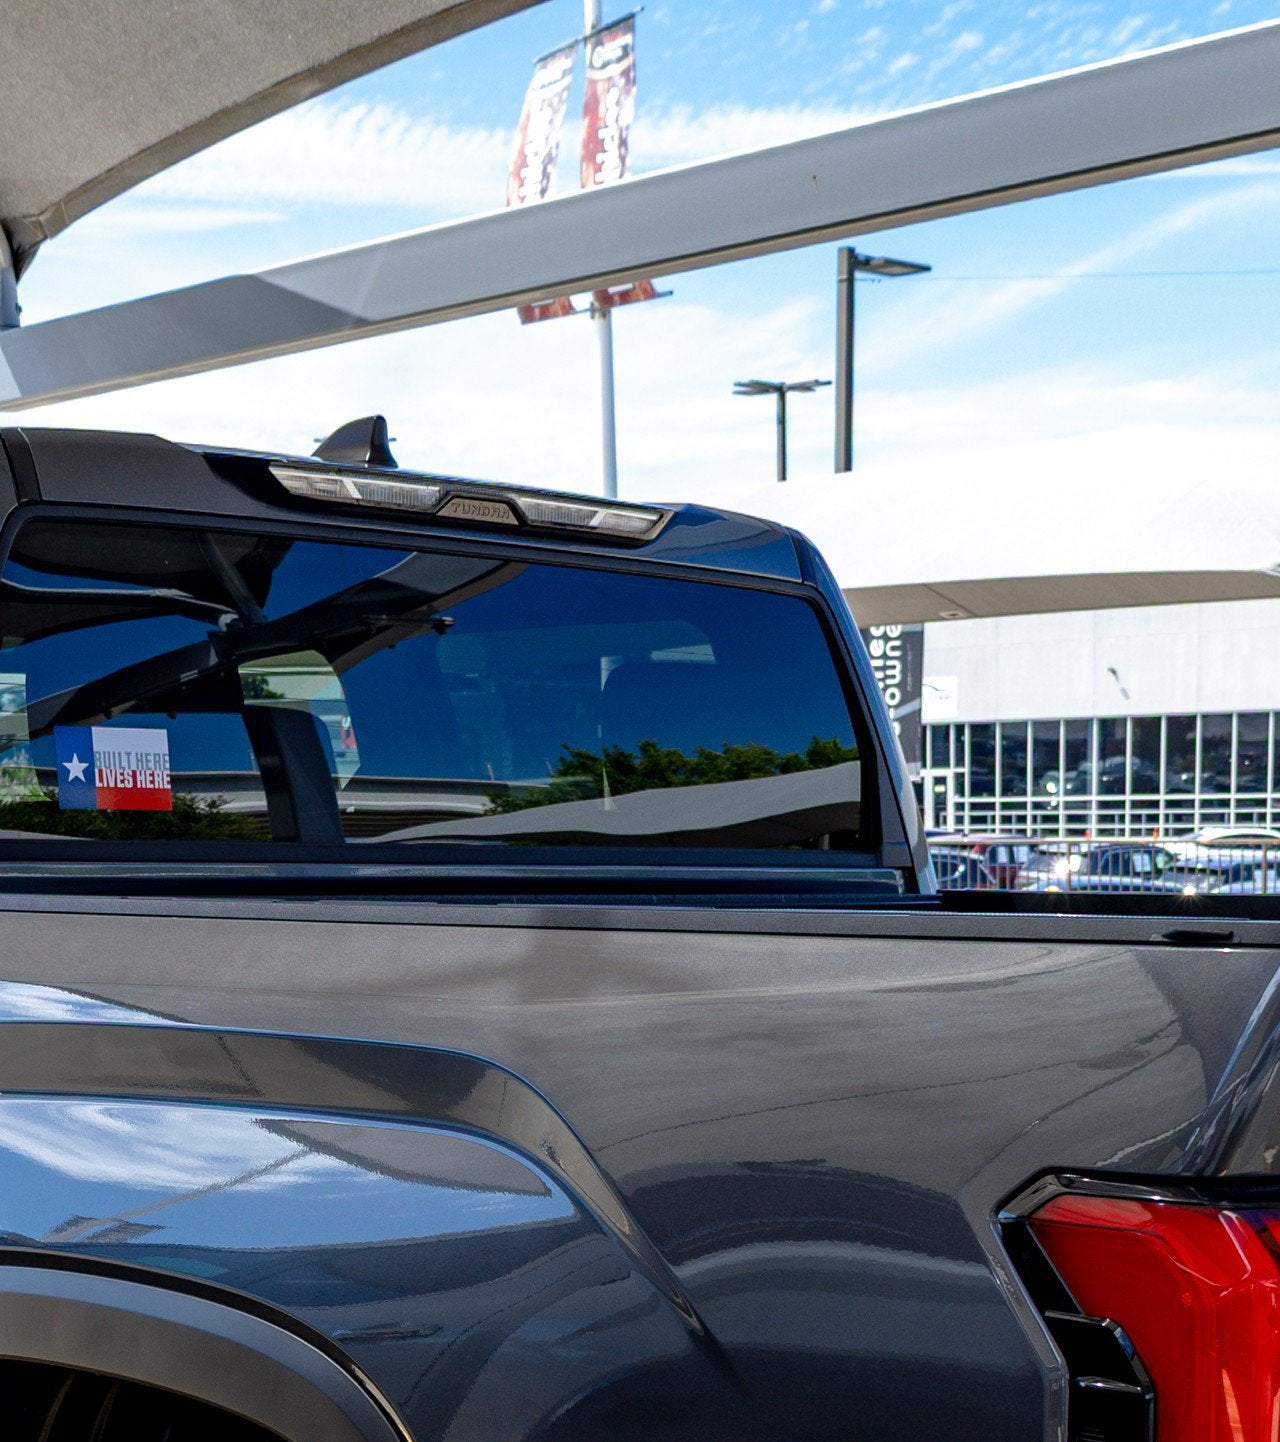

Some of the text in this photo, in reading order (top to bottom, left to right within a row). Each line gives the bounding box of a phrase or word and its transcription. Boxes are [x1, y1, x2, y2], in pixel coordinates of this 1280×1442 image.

[451, 503, 510, 520] TUNDRA
[95, 751, 170, 771] BUILT HERE
[96, 768, 171, 789] LIVES HERE
